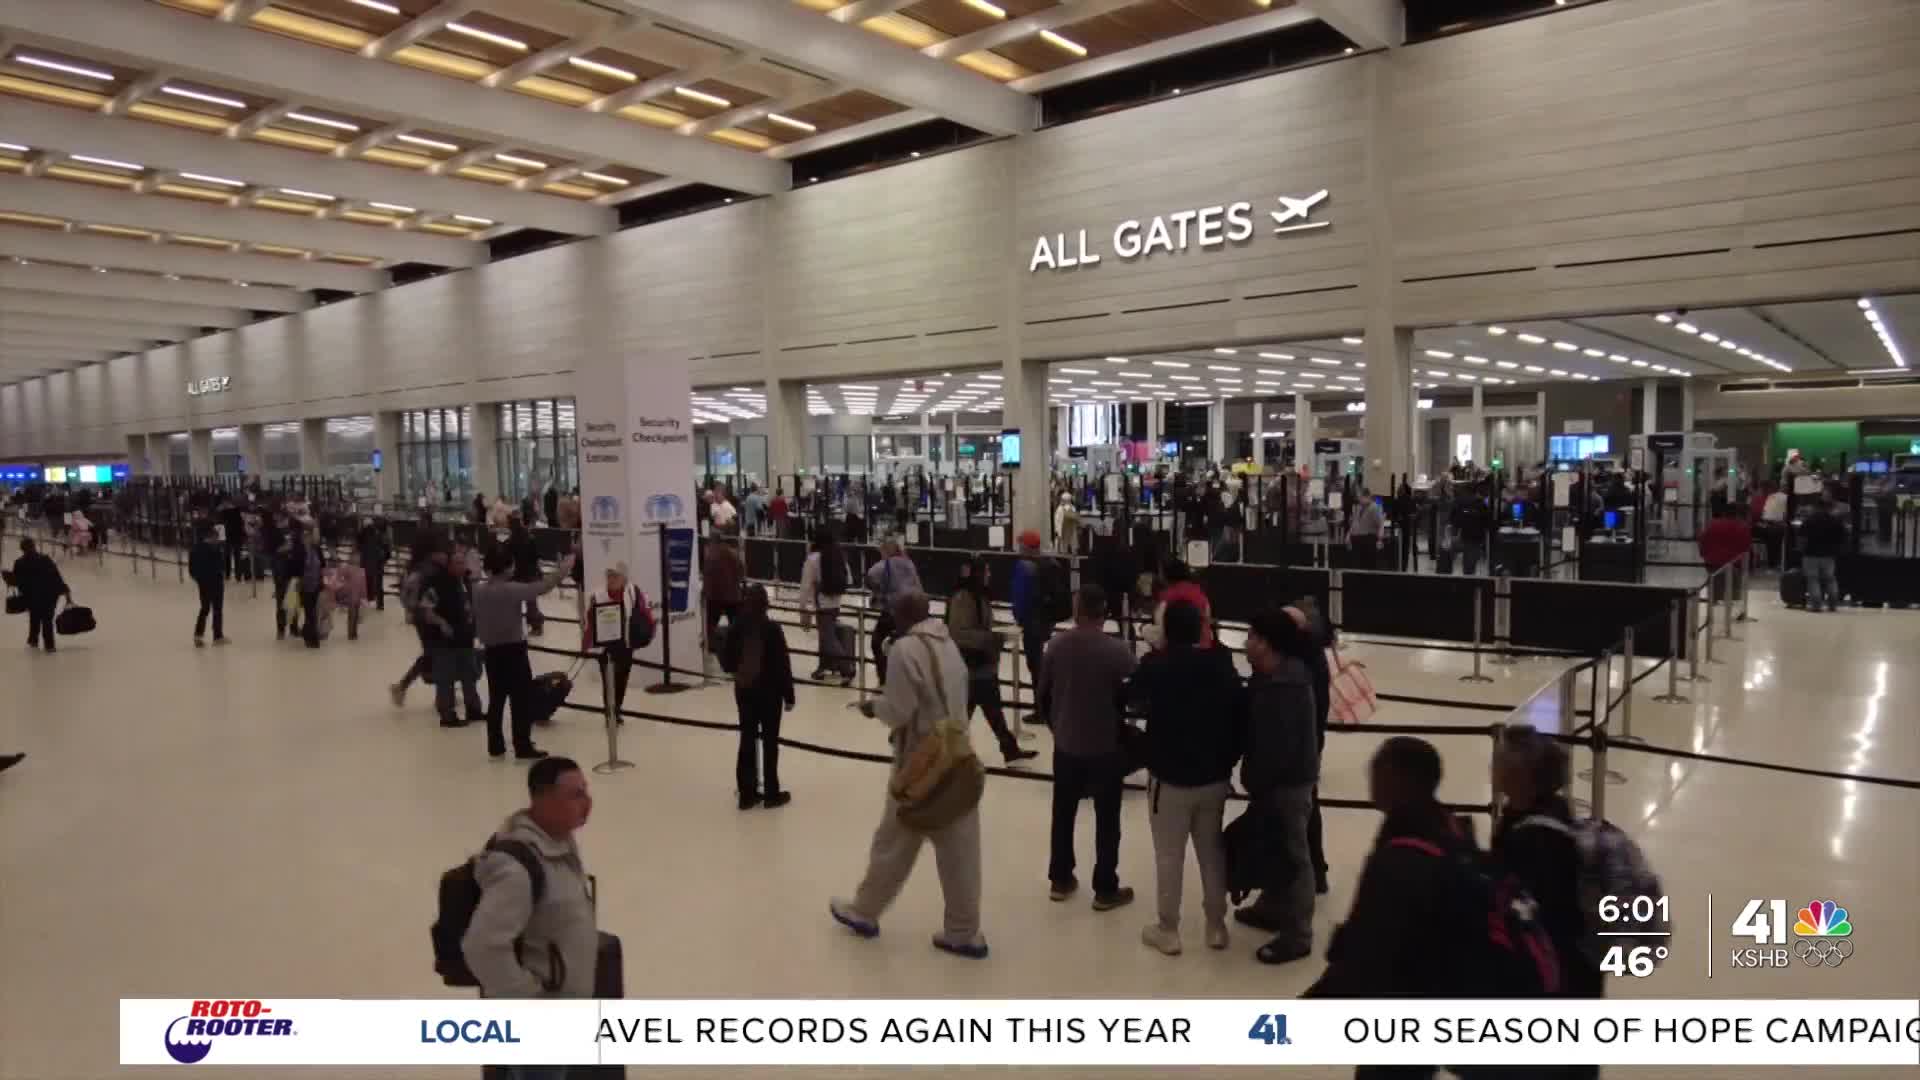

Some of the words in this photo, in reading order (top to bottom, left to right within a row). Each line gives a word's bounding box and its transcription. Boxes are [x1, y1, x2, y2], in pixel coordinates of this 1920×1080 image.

[1030, 229, 1101, 272] ALL
[1112, 201, 1254, 258] GATES
[639, 416, 680, 430] Security
[632, 432, 688, 445] Checkpoint
